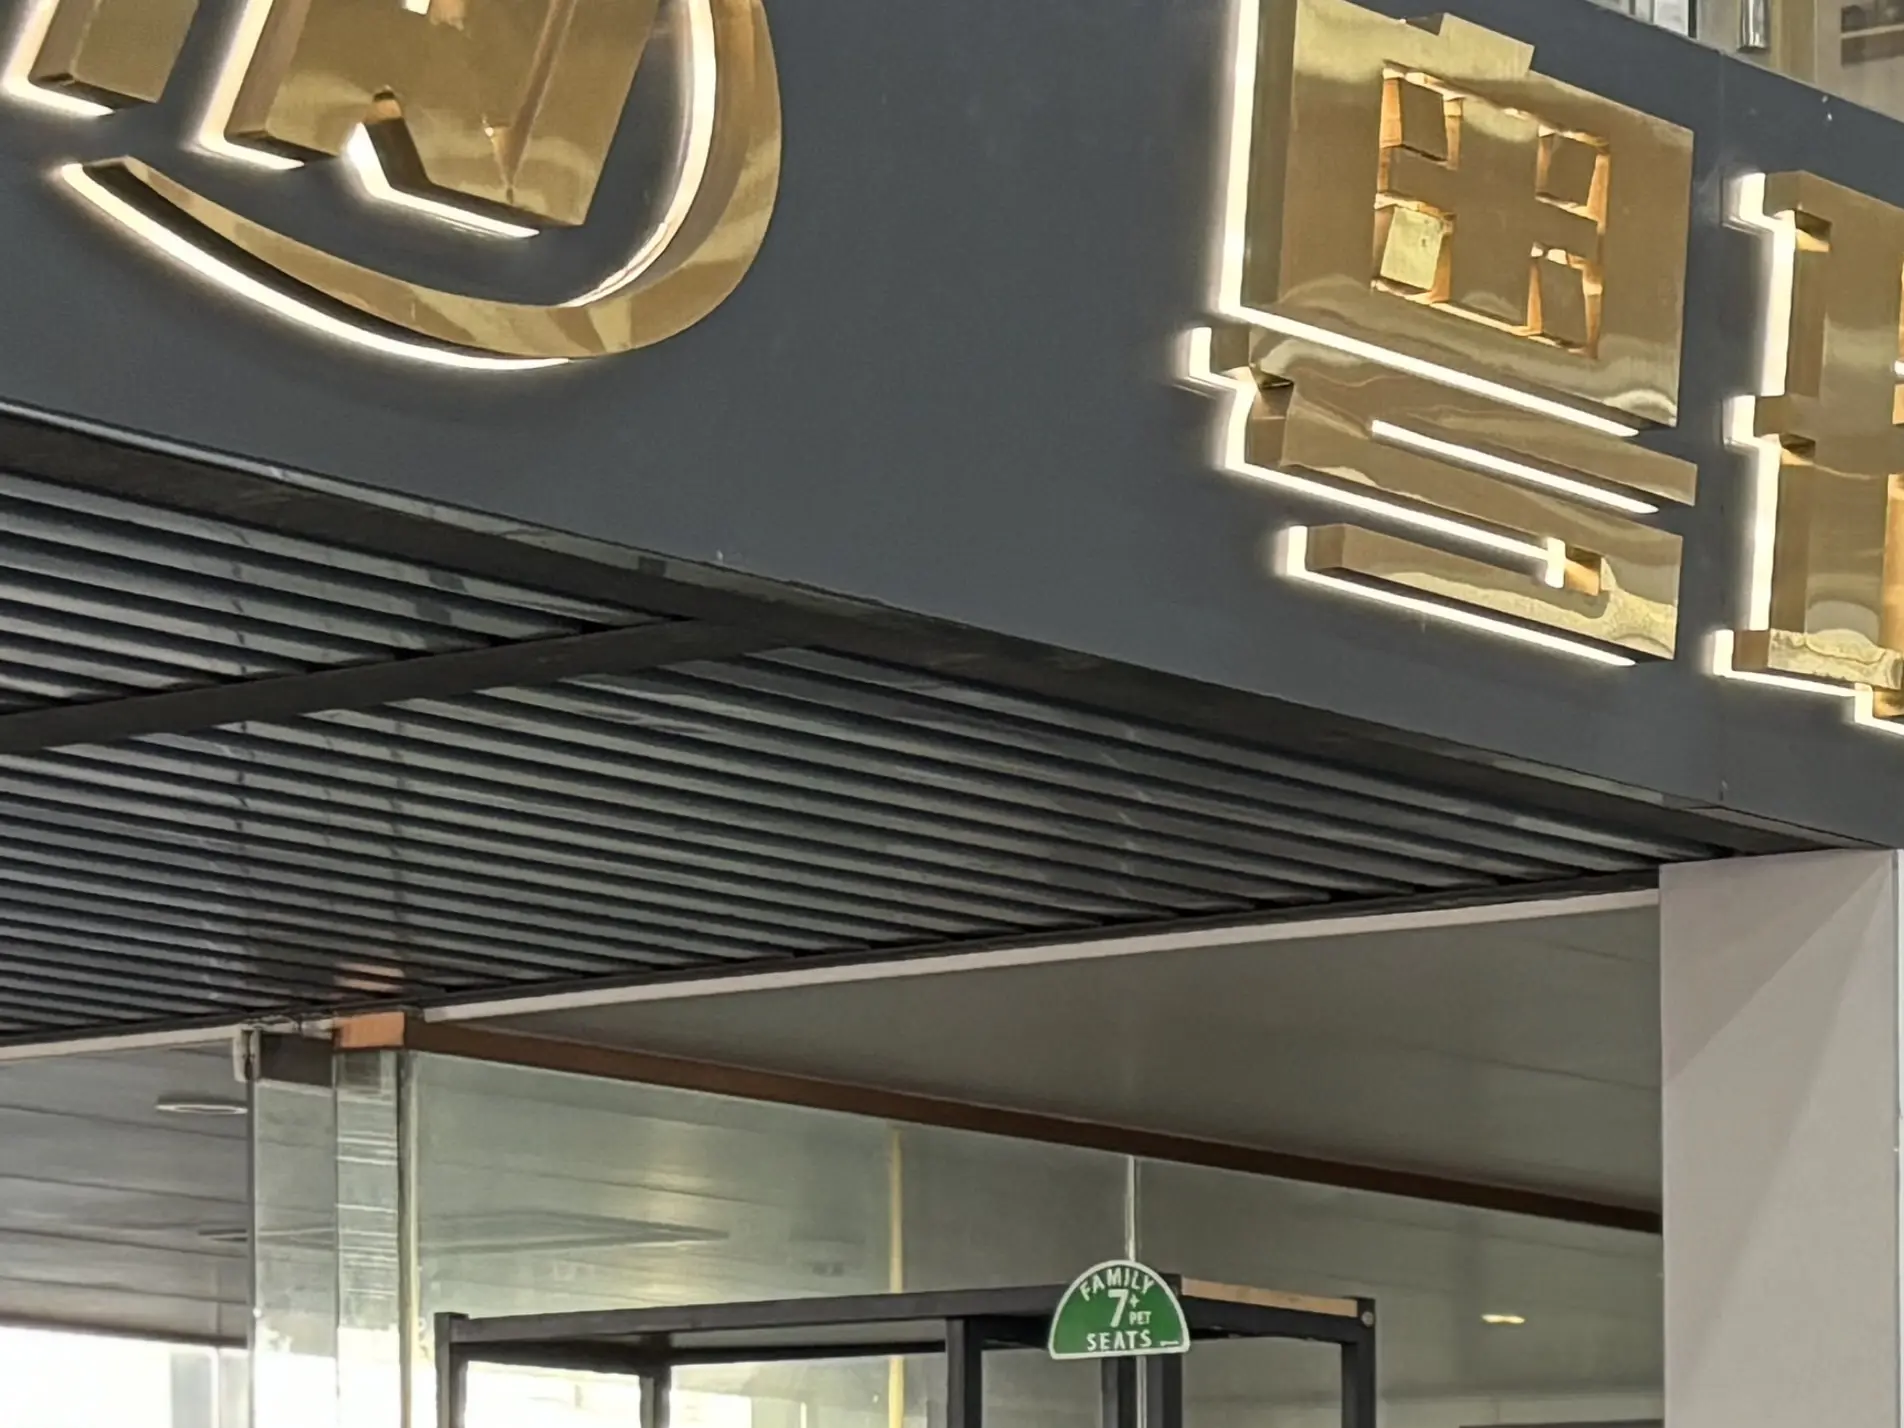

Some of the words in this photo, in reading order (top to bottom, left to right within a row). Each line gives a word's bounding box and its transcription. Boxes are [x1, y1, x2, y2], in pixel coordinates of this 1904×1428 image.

[1079, 1266, 1155, 1301] FAMILY
[1129, 1310, 1151, 1325] PET
[1086, 1329, 1152, 1351] SEATS
